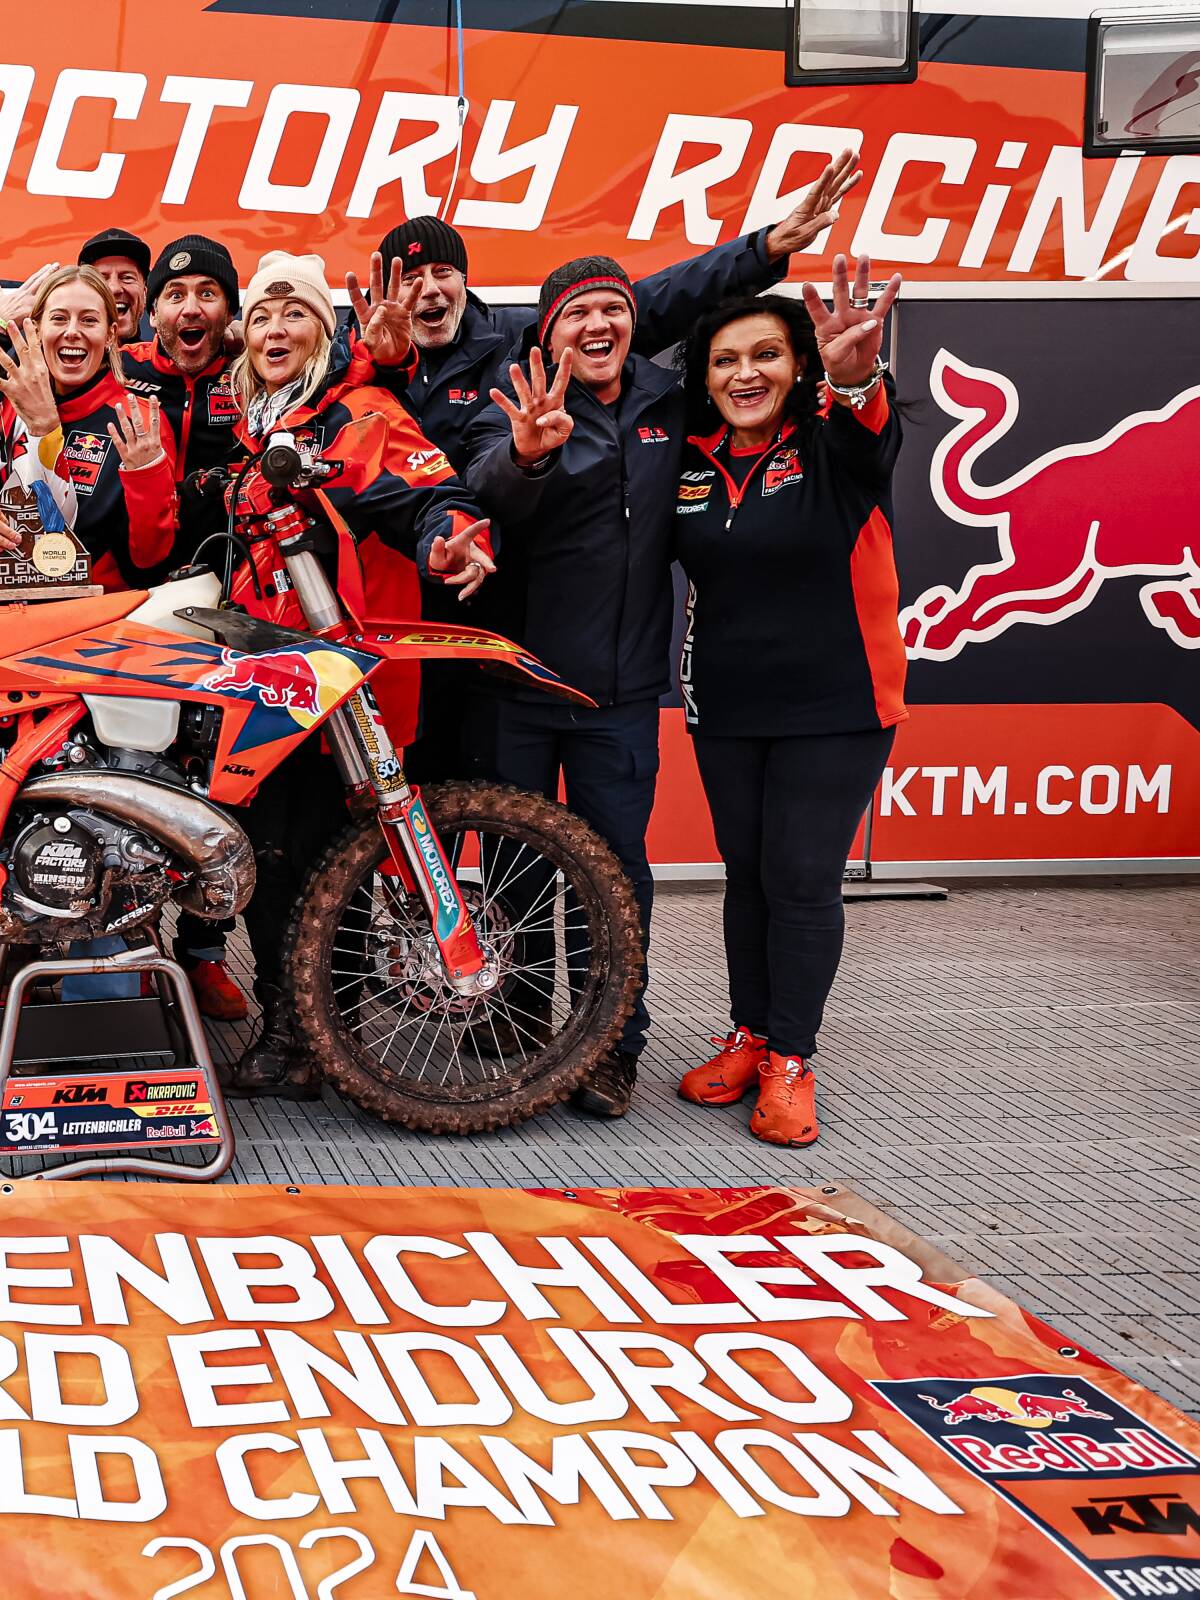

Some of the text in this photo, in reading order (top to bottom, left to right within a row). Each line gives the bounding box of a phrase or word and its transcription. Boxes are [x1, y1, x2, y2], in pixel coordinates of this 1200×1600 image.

[676, 503, 705, 514] OTOREX
[14, 559, 88, 575] ENO
[418, 634, 498, 647] DHL
[221, 763, 257, 778] KTM
[880, 764, 1173, 817] KTM.COM
[34, 856, 88, 867] FACTORY
[40, 842, 83, 859] KTM
[419, 832, 459, 915] MOTOREX
[105, 903, 155, 933] ACERBIS
[51, 1083, 108, 1105] KTM
[155, 1104, 197, 1116] DHL
[5, 1112, 142, 1142] 304 LETTENBICHLER
[146, 1124, 187, 1139] Red Bull
[167, 1327, 854, 1428] ENDURO
[941, 1428, 1197, 1473] Red Bull
[215, 1427, 965, 1527] CHAMPION
[140, 1527, 468, 1600] 2024
[1104, 1566, 1200, 1597] FACTO
